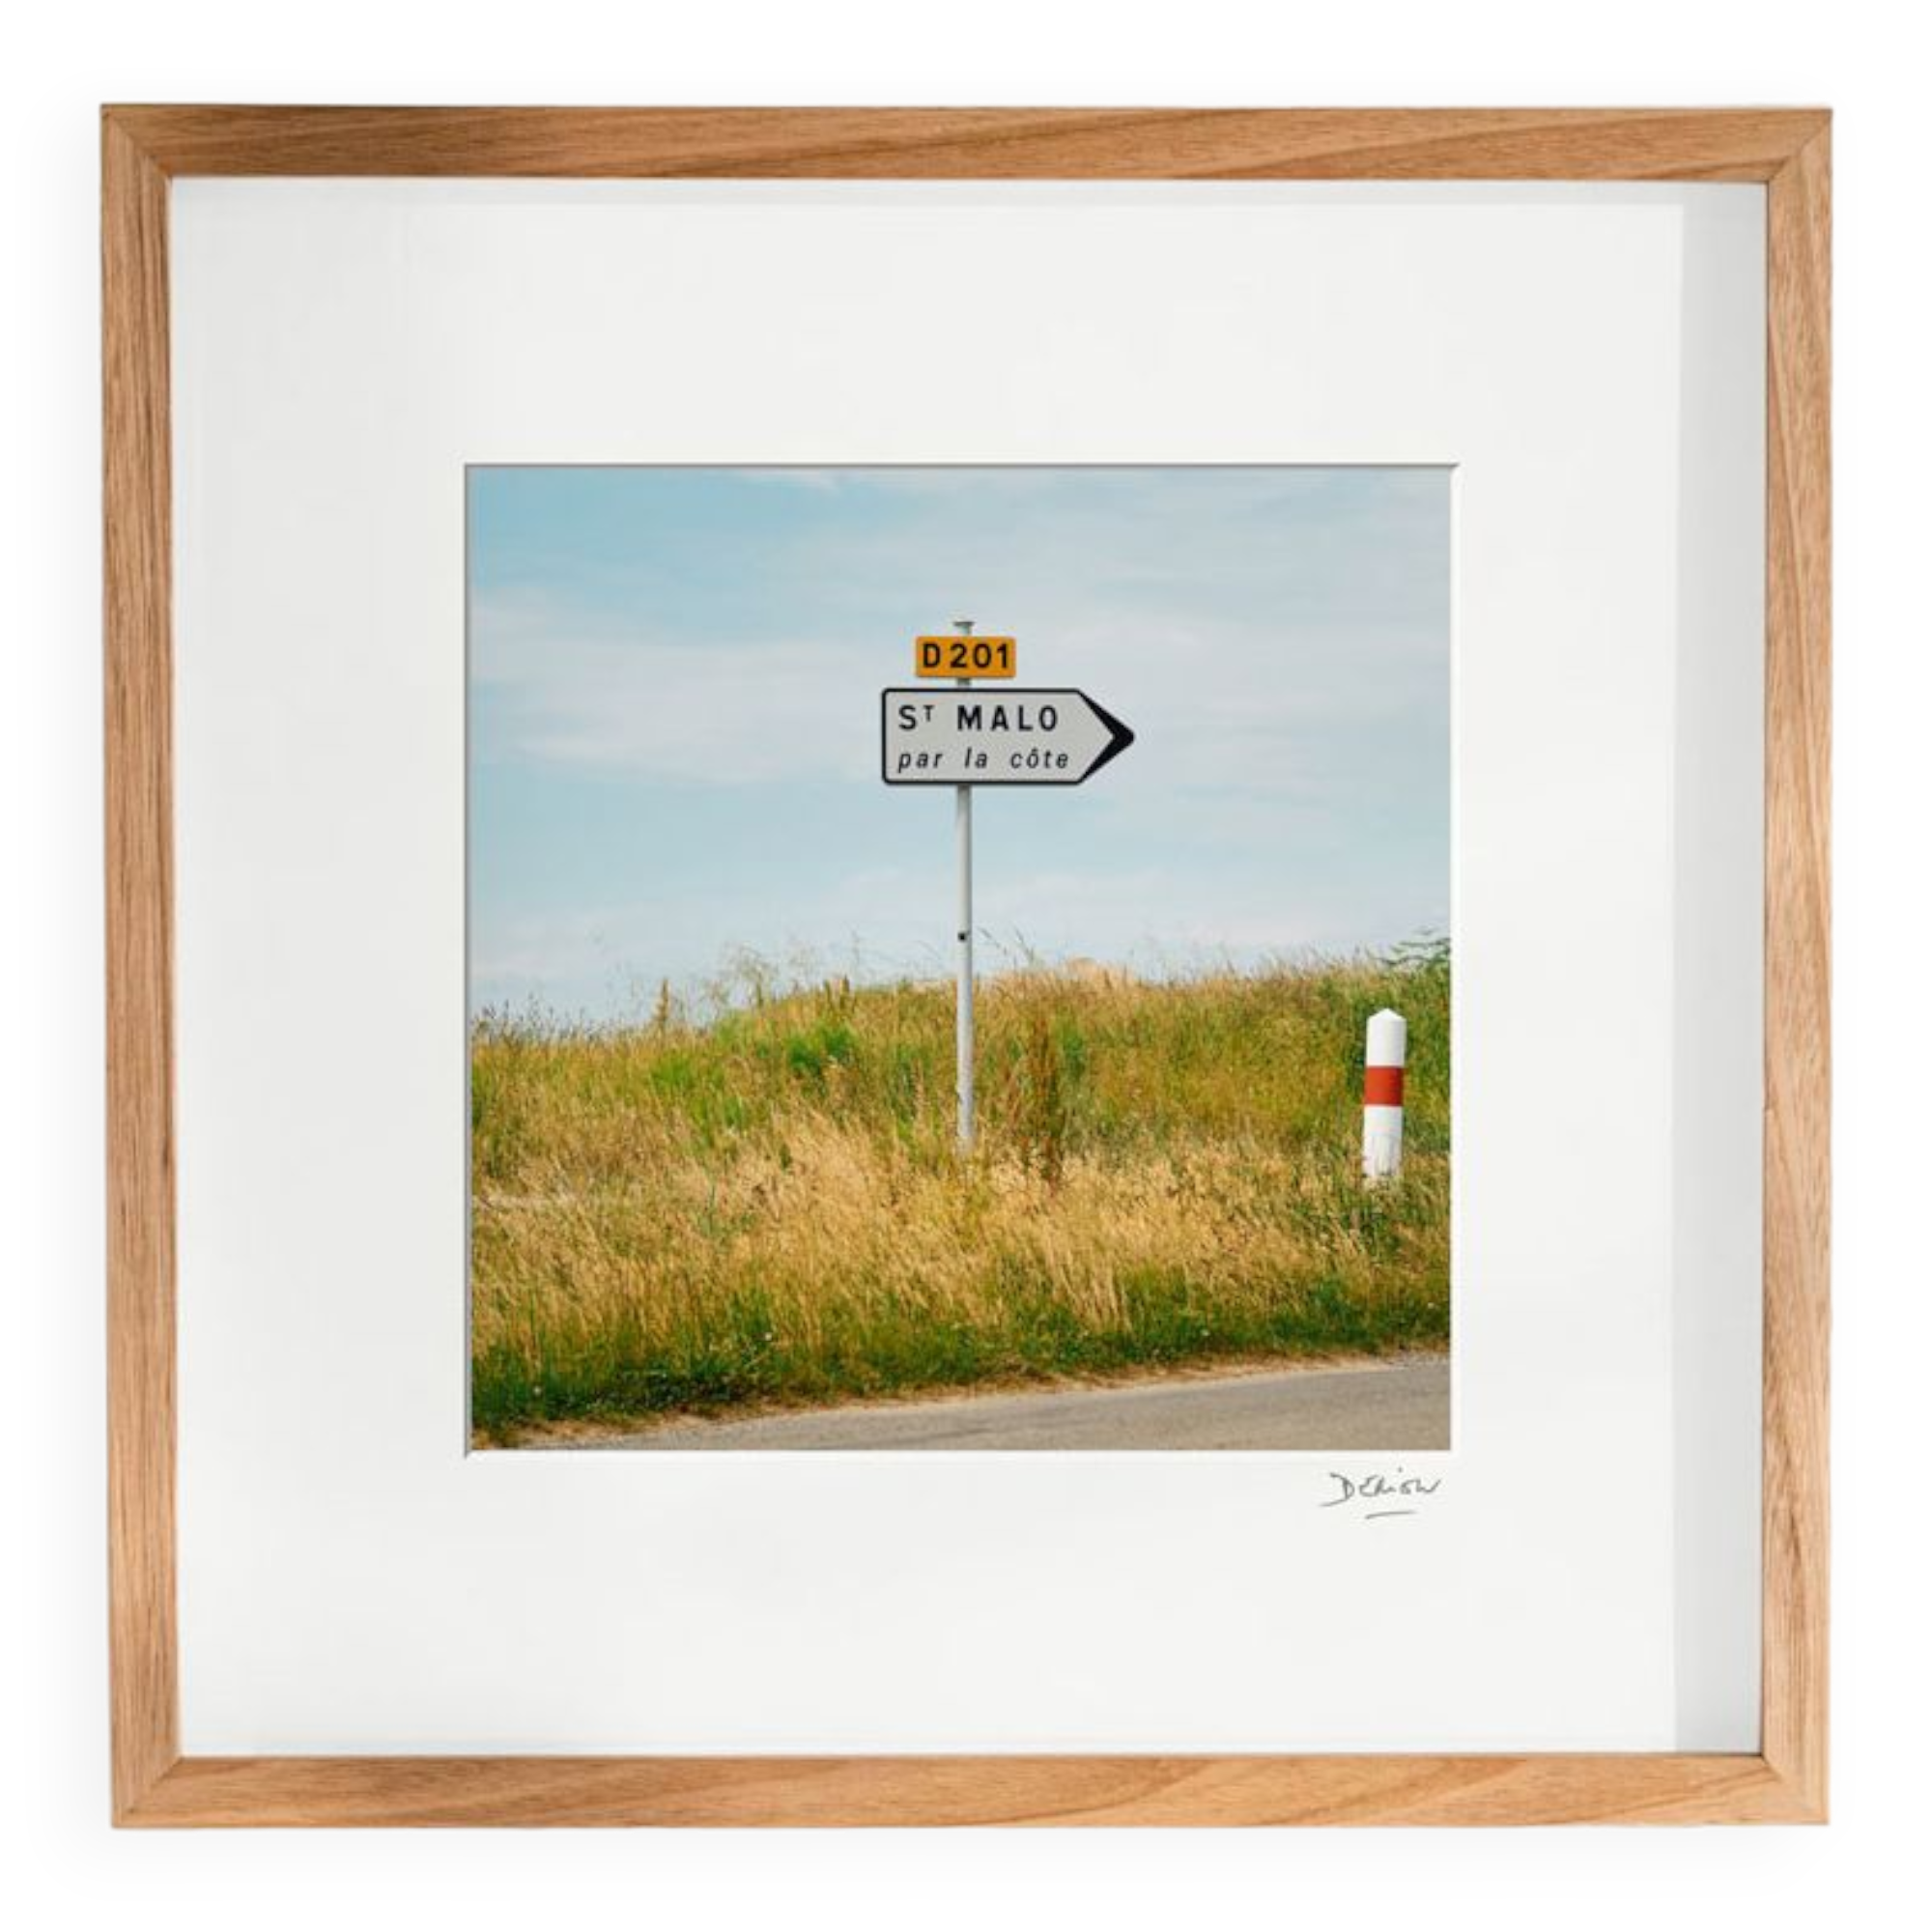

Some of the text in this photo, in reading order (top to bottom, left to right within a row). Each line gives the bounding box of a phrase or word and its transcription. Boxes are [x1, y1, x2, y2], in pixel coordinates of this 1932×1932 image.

[956, 704, 1059, 732] MALO
[897, 747, 1069, 774] par la côte
